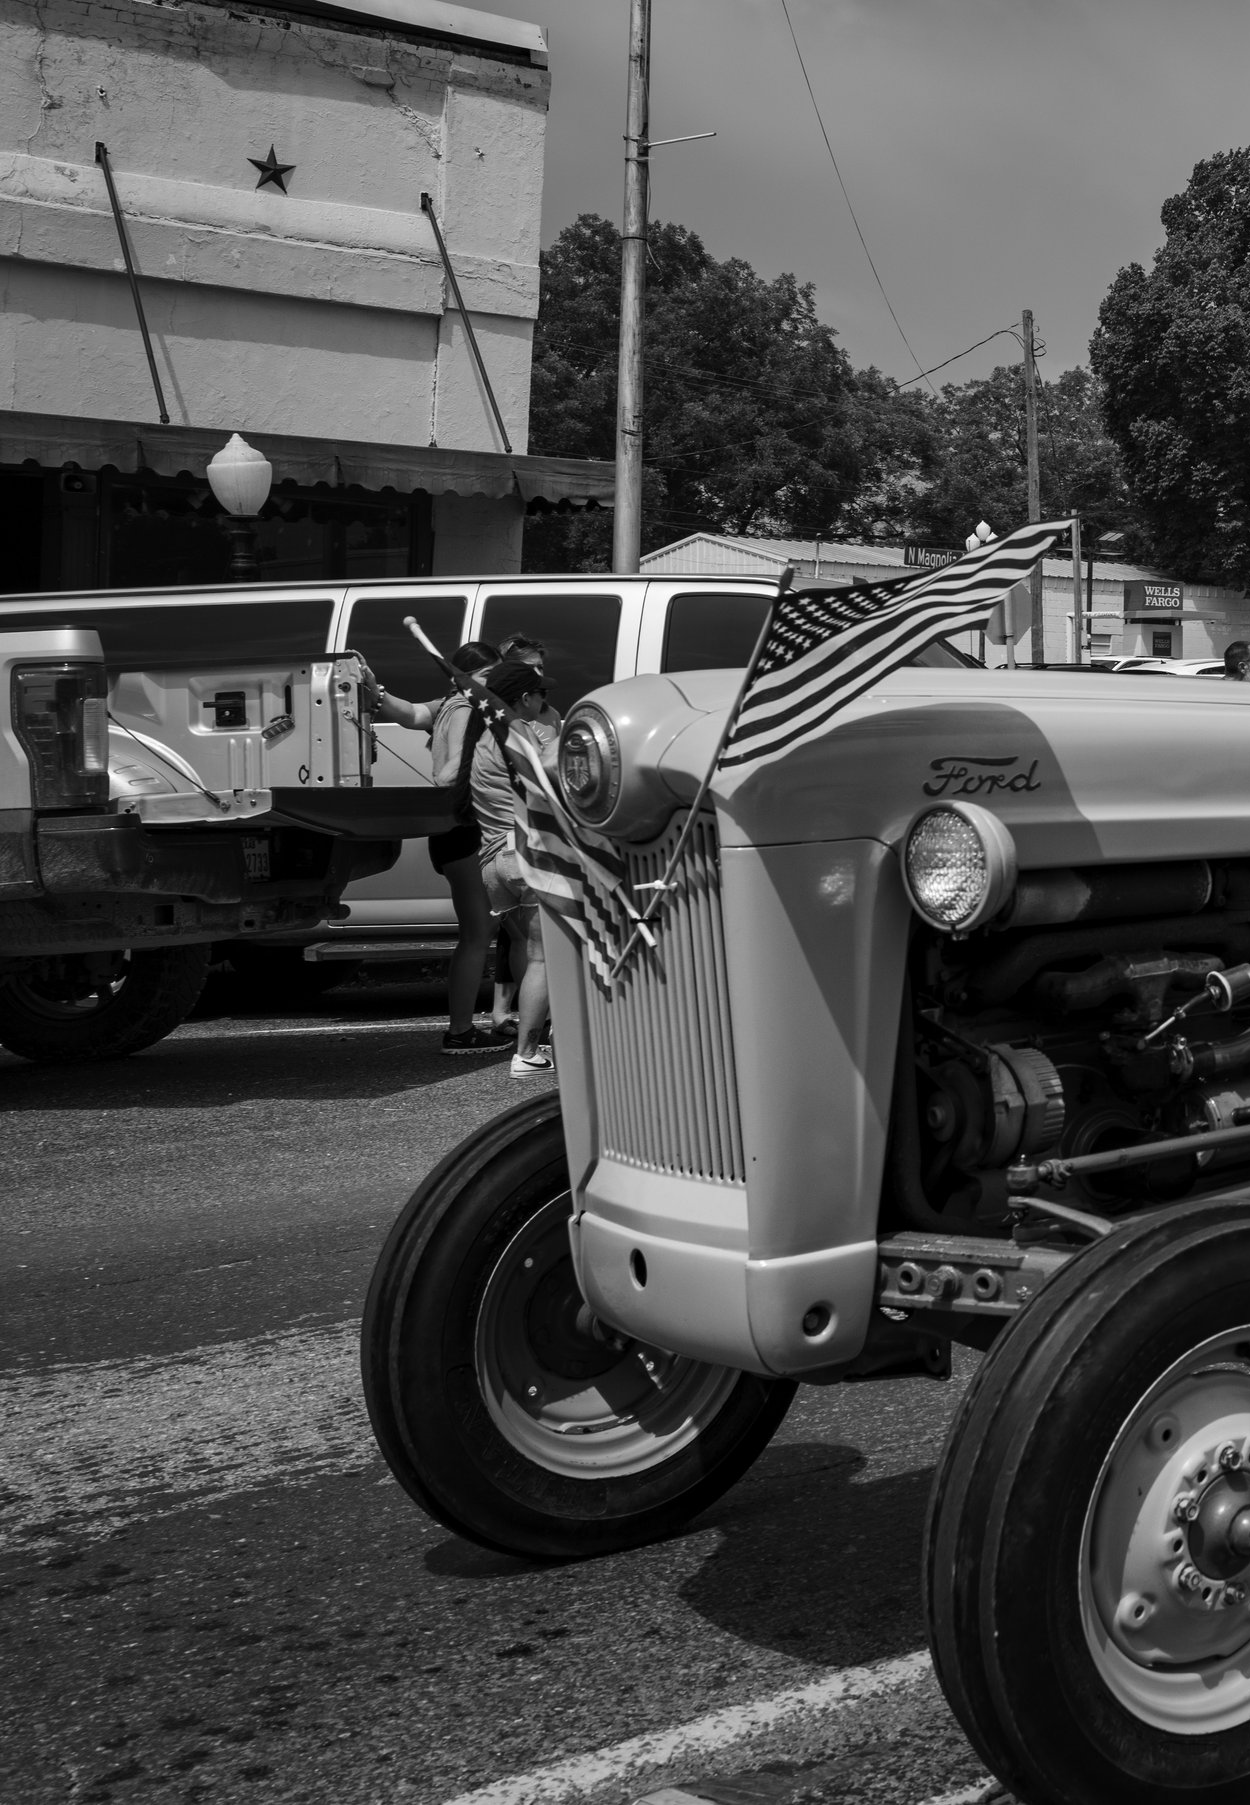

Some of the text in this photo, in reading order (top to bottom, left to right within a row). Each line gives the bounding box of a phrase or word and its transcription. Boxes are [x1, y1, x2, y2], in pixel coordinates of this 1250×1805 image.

[908, 547, 916, 564] N
[1144, 585, 1180, 597] WELLS
[1145, 597, 1180, 607] FARGO
[922, 755, 1041, 796] Ford
